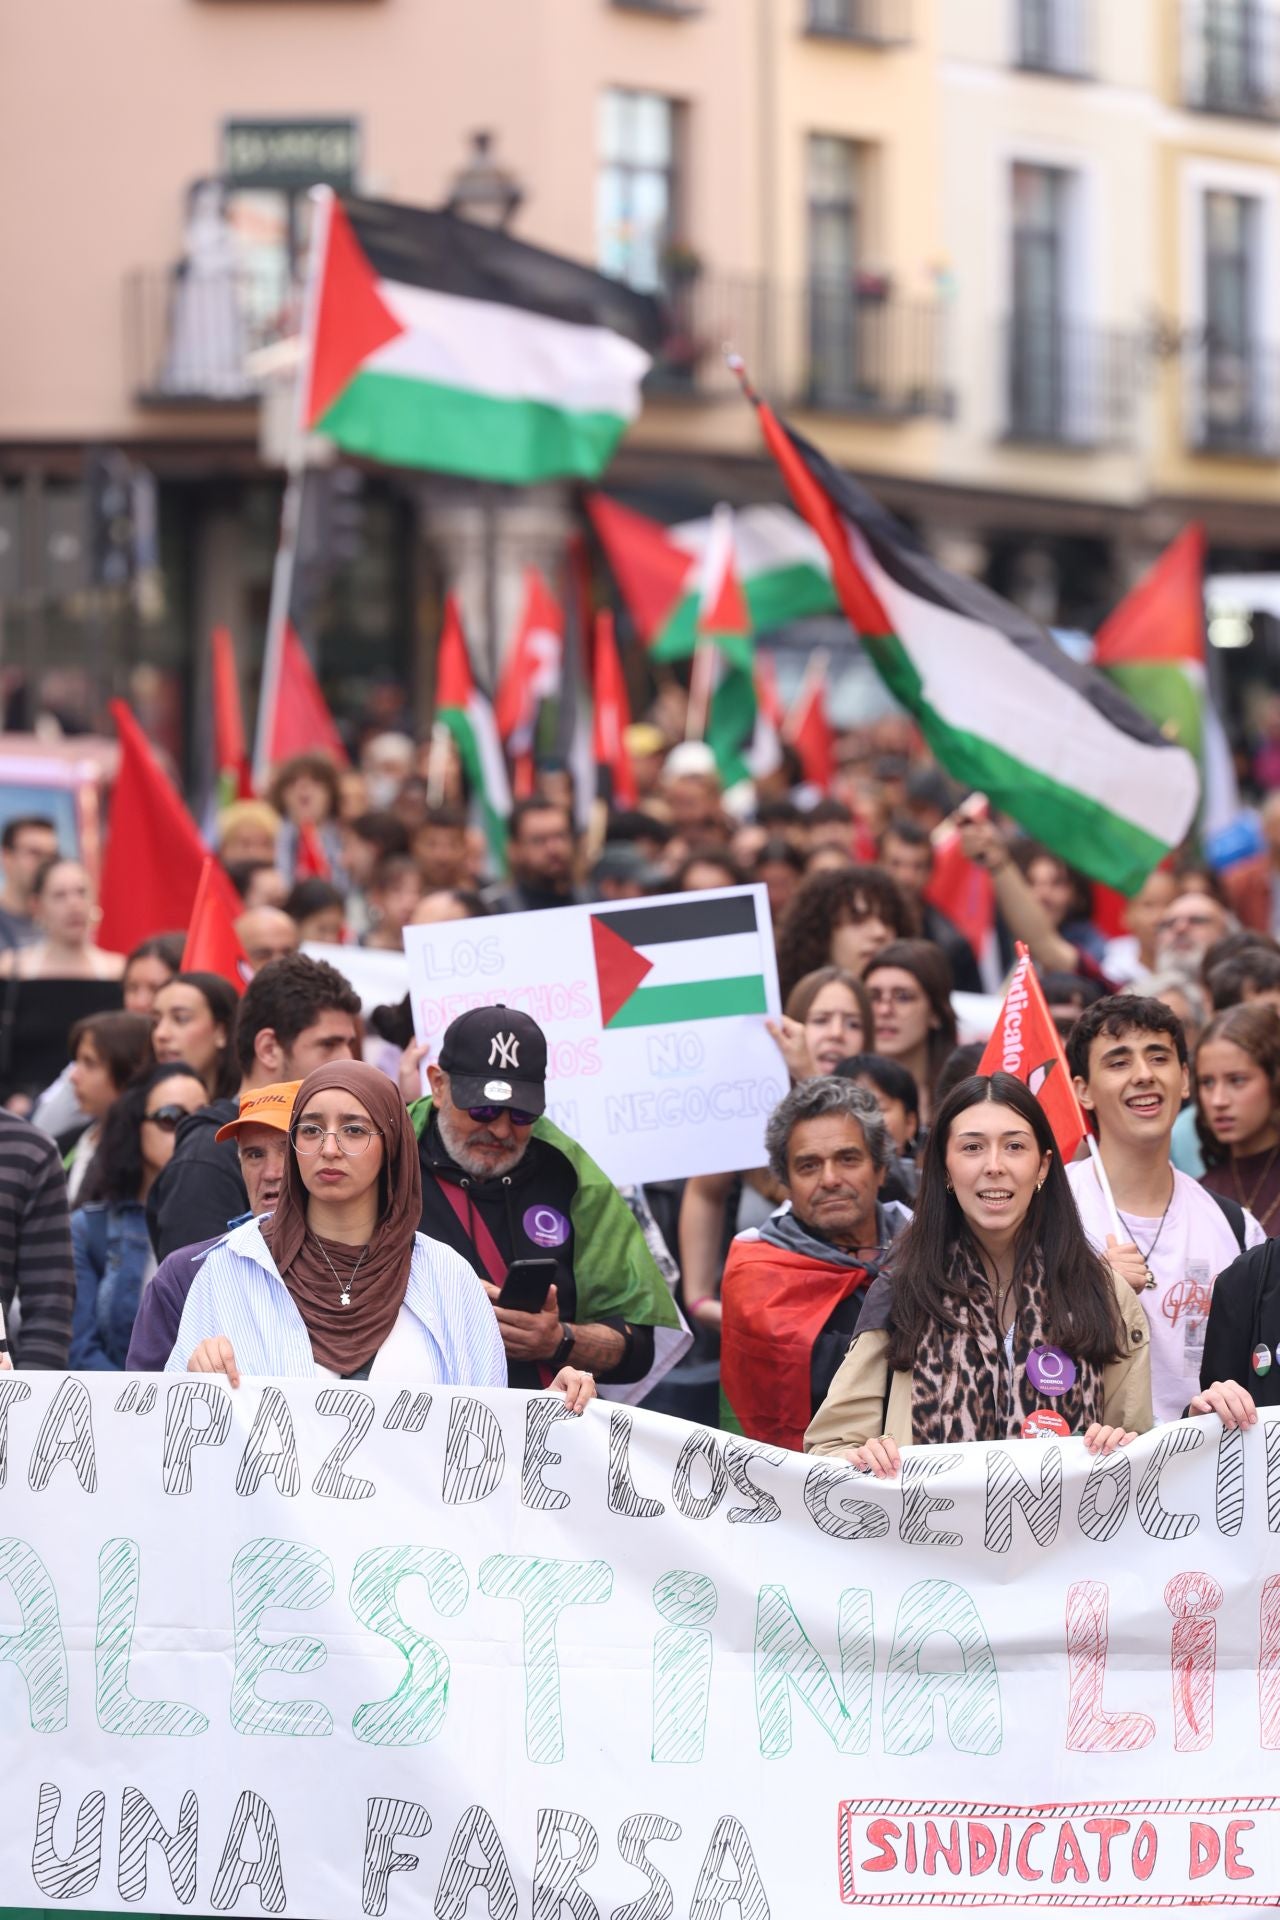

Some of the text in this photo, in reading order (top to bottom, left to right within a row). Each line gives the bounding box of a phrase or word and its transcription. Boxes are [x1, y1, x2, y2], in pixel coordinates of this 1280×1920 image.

[423, 936, 504, 981] LOS
[647, 1030, 704, 1076] NO
[247, 1095, 287, 1108] STIHL
[605, 1077, 785, 1135] NEGOCIO
[442, 1397, 584, 1511] DE
[608, 1409, 789, 1524] LOS
[804, 1420, 1280, 1553] GENOCI
[32, 1782, 771, 1920] UNA FARSA
[861, 1819, 1255, 1884] SINDICATO DE
